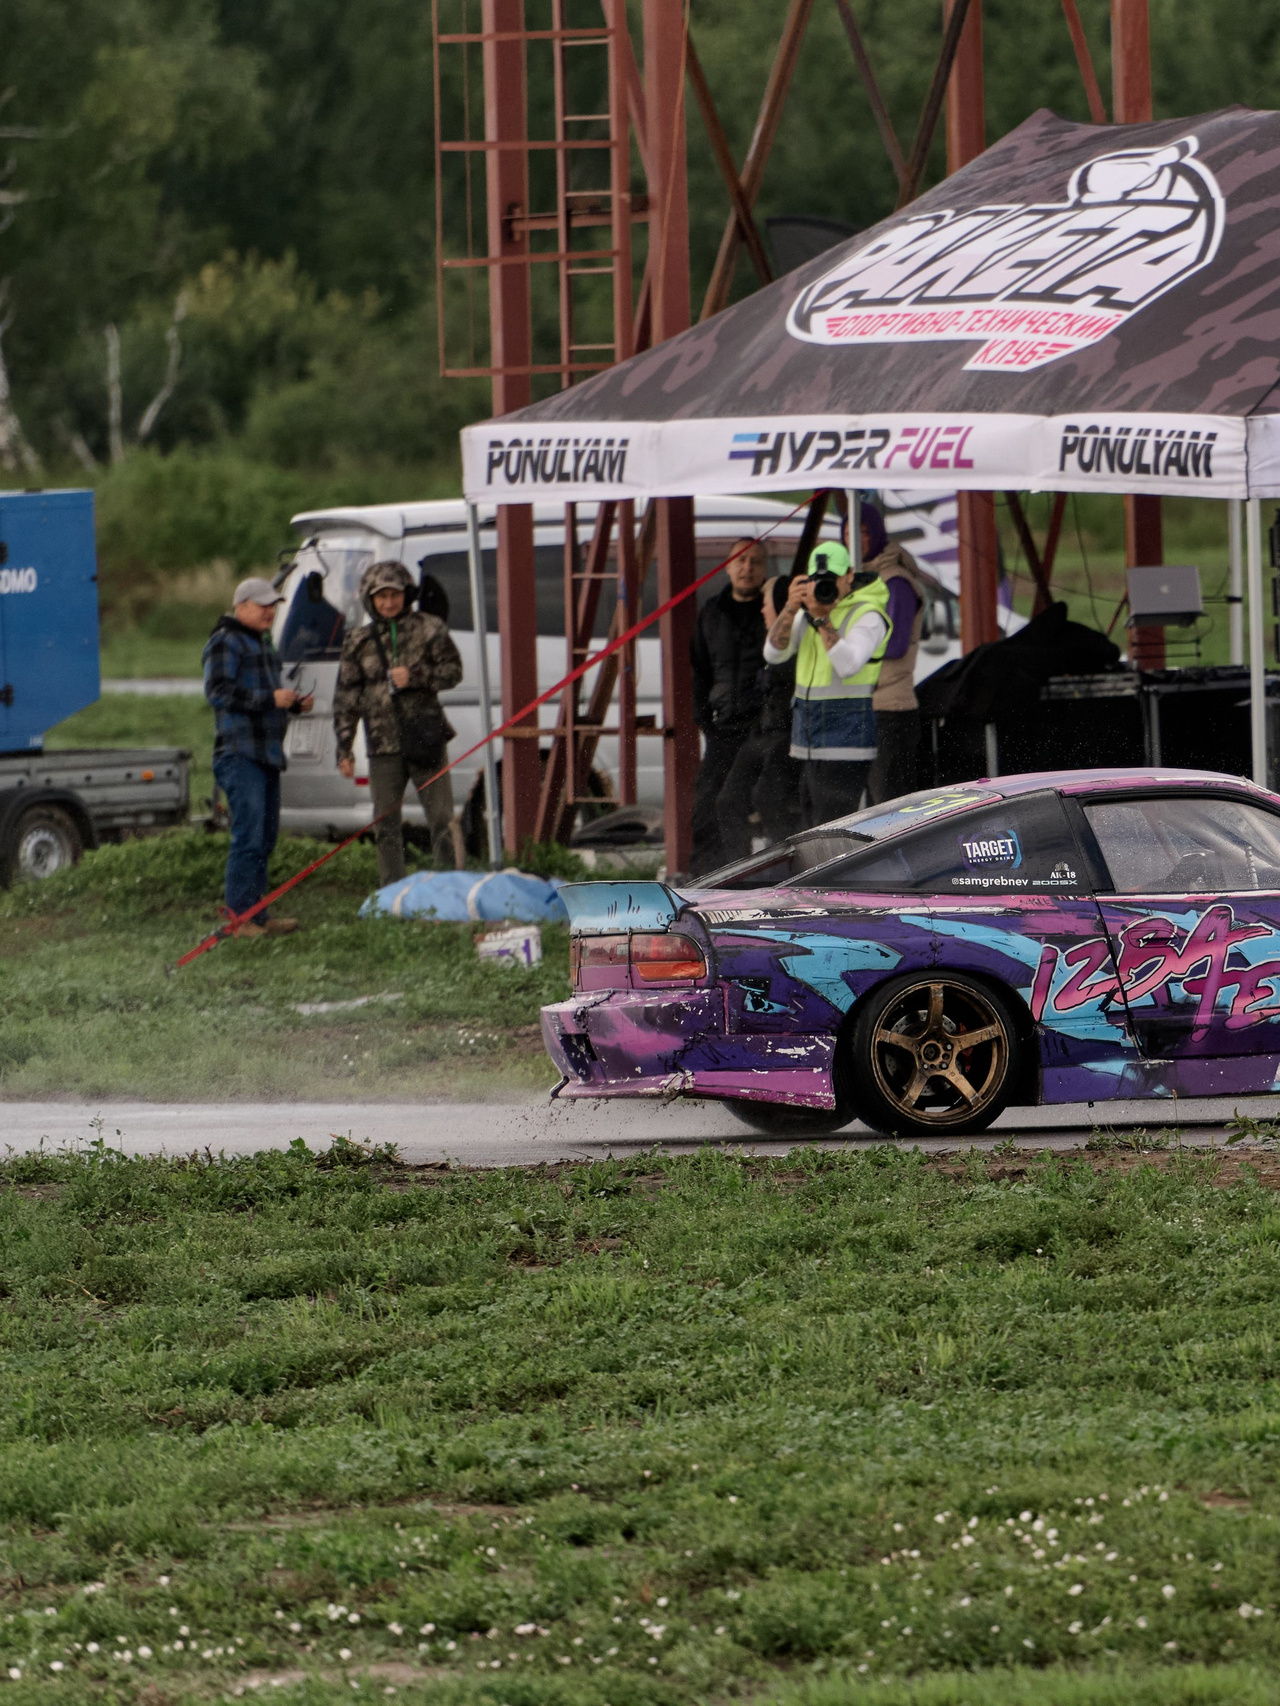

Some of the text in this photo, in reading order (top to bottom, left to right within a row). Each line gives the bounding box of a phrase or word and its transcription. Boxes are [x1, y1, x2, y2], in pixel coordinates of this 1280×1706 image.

[806, 204, 1202, 310] РАКЕТА
[832, 310, 1123, 340] СПОРТИВНО-ТЕХНИЧЕСКИЙ
[972, 339, 1048, 366] КЛУБ
[0, 566, 38, 595] DMO
[962, 838, 1015, 859] TARGET
[1050, 871, 1077, 879] AK-18
